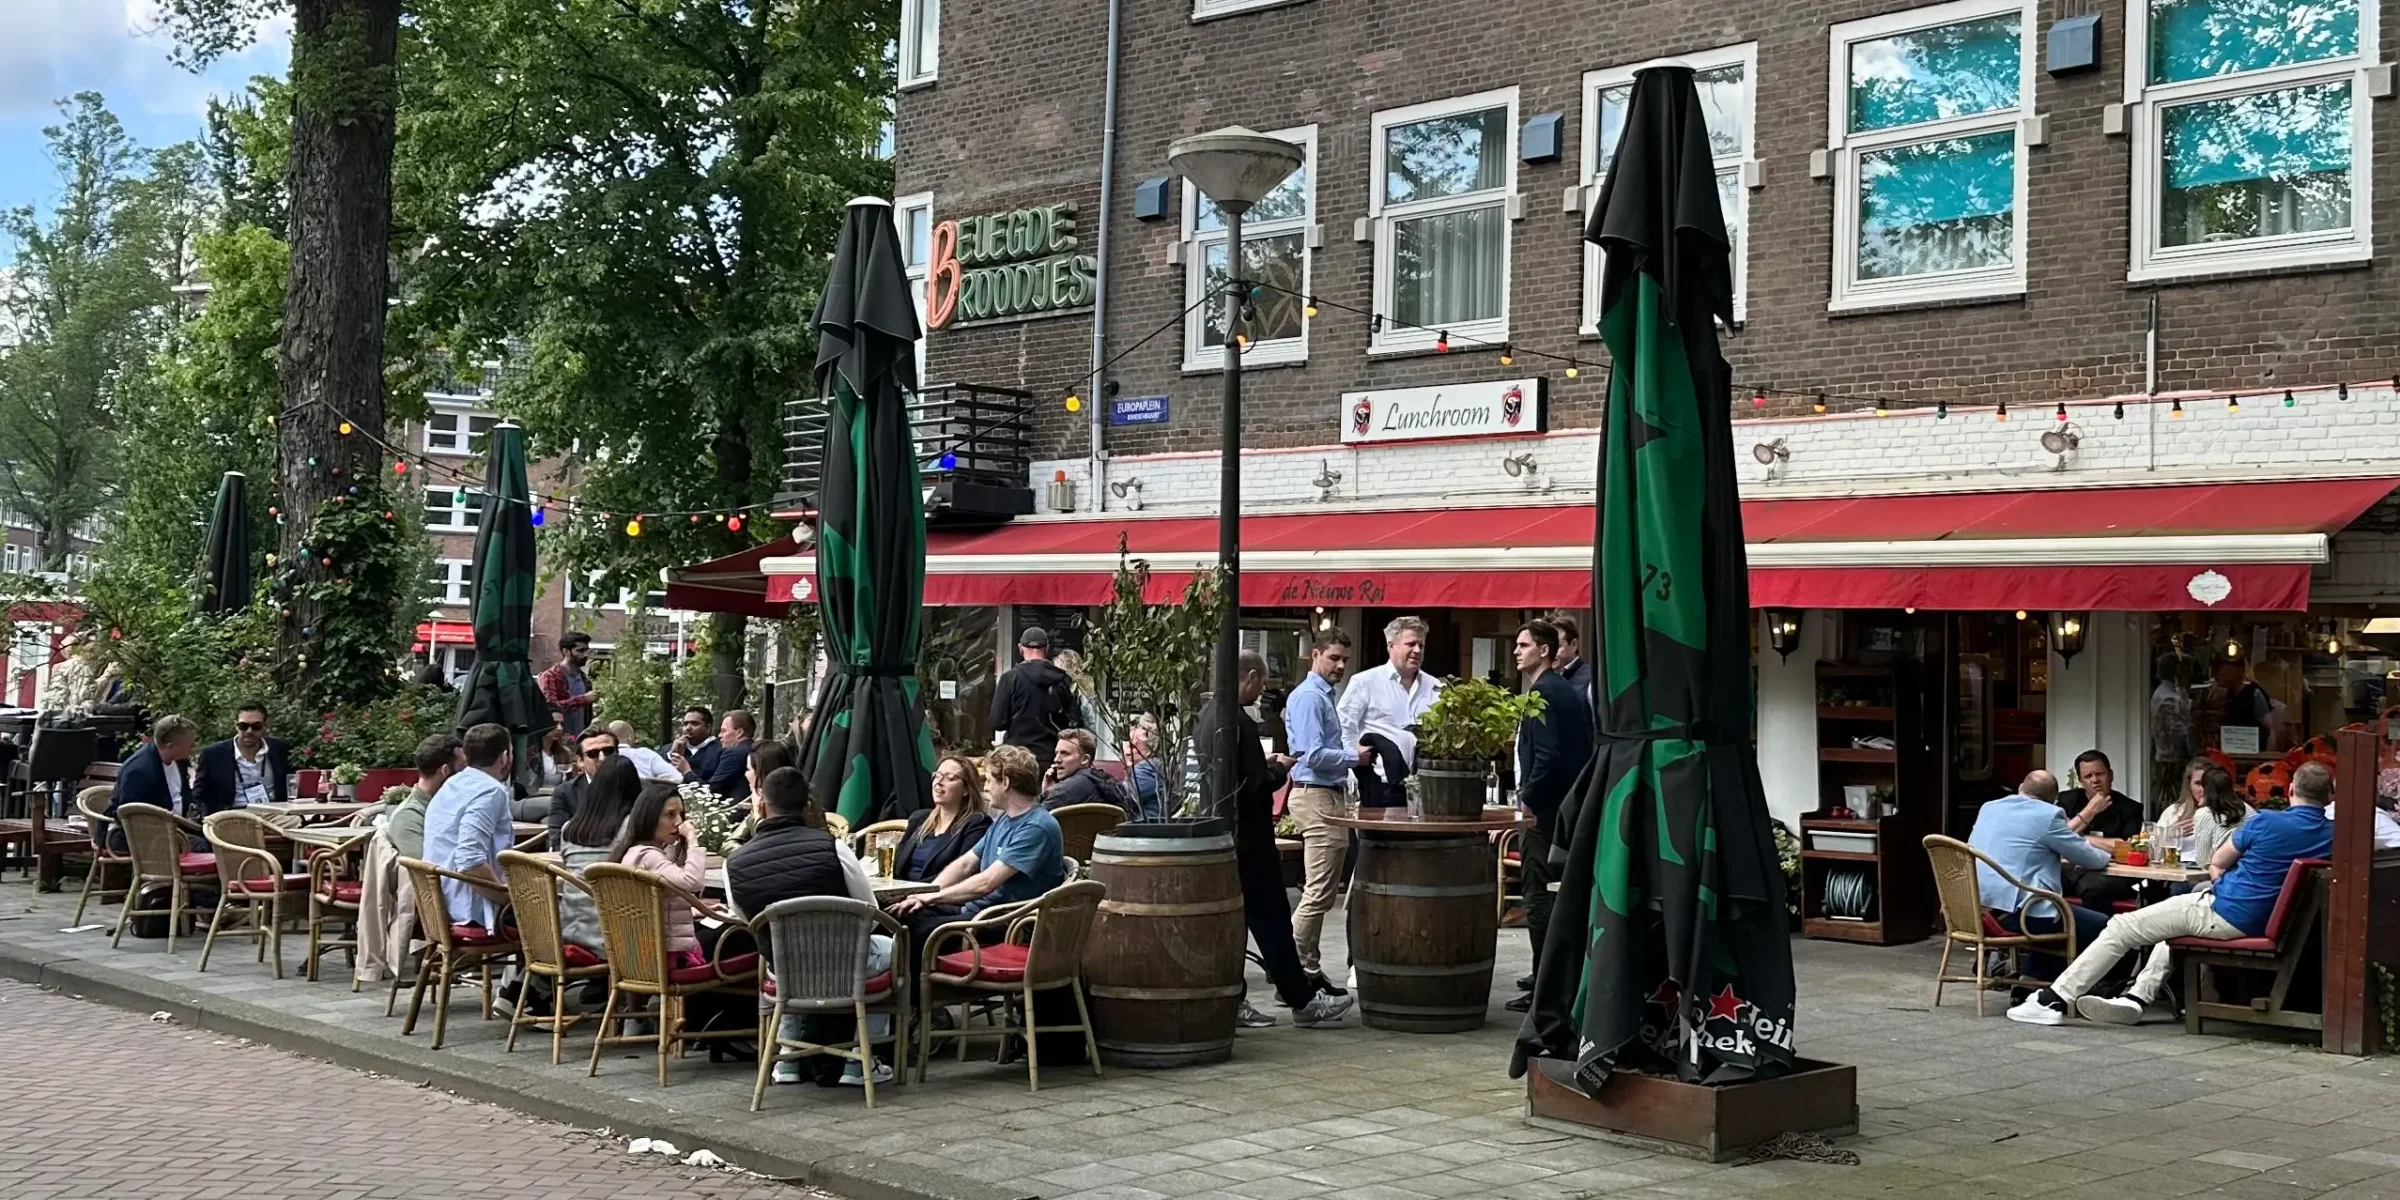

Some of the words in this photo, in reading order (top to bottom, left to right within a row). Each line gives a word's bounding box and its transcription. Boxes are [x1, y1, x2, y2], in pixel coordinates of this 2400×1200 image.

[1117, 399, 1161, 413] EUROPAPLEIN
[1381, 393, 1490, 432] Lunchroom
[1281, 575, 1298, 600] de
[1302, 578, 1355, 601] Nieuwe
